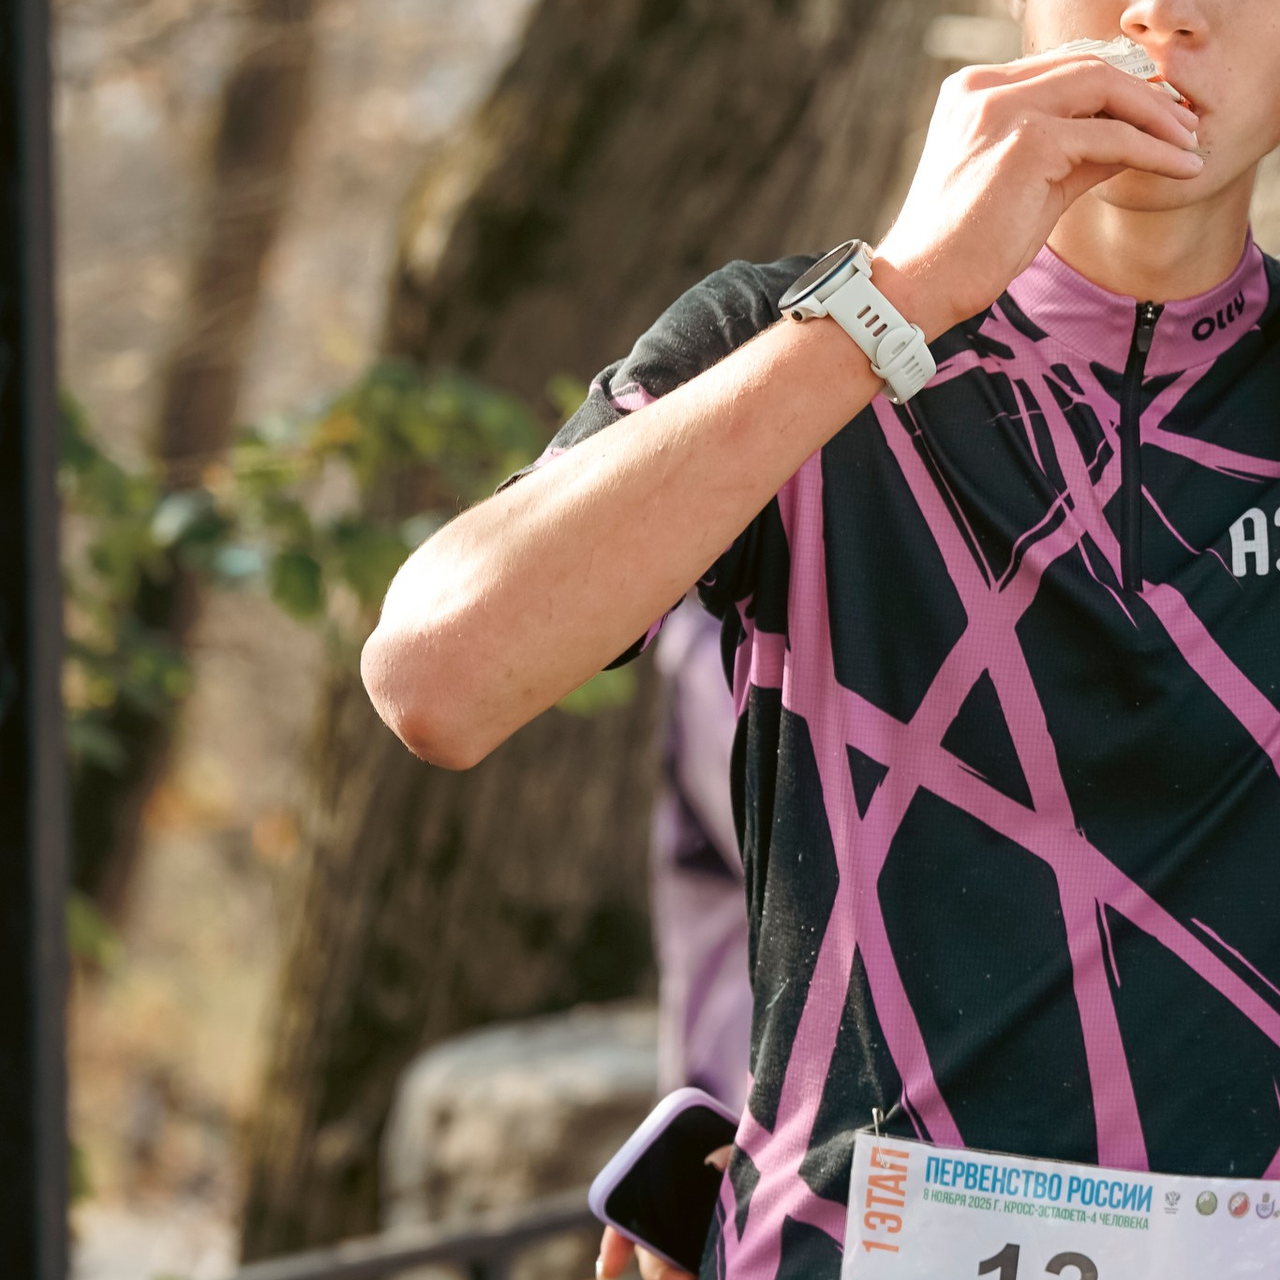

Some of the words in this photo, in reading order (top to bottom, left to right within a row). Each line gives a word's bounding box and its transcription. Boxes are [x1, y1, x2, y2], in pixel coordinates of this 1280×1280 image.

[864, 1147, 910, 1234] ЭТАП
[925, 1156, 1062, 1201] ПЕРВЕНСТВО
[1067, 1176, 1153, 1212] РОССИИ
[923, 1188, 929, 1201] 8
[931, 1190, 966, 1207] НОЯБРЯ
[968, 1197, 992, 1210] 2025
[1099, 1212, 1149, 1230] ЧЕЛОВЕКА
[862, 1240, 900, 1253] 1
